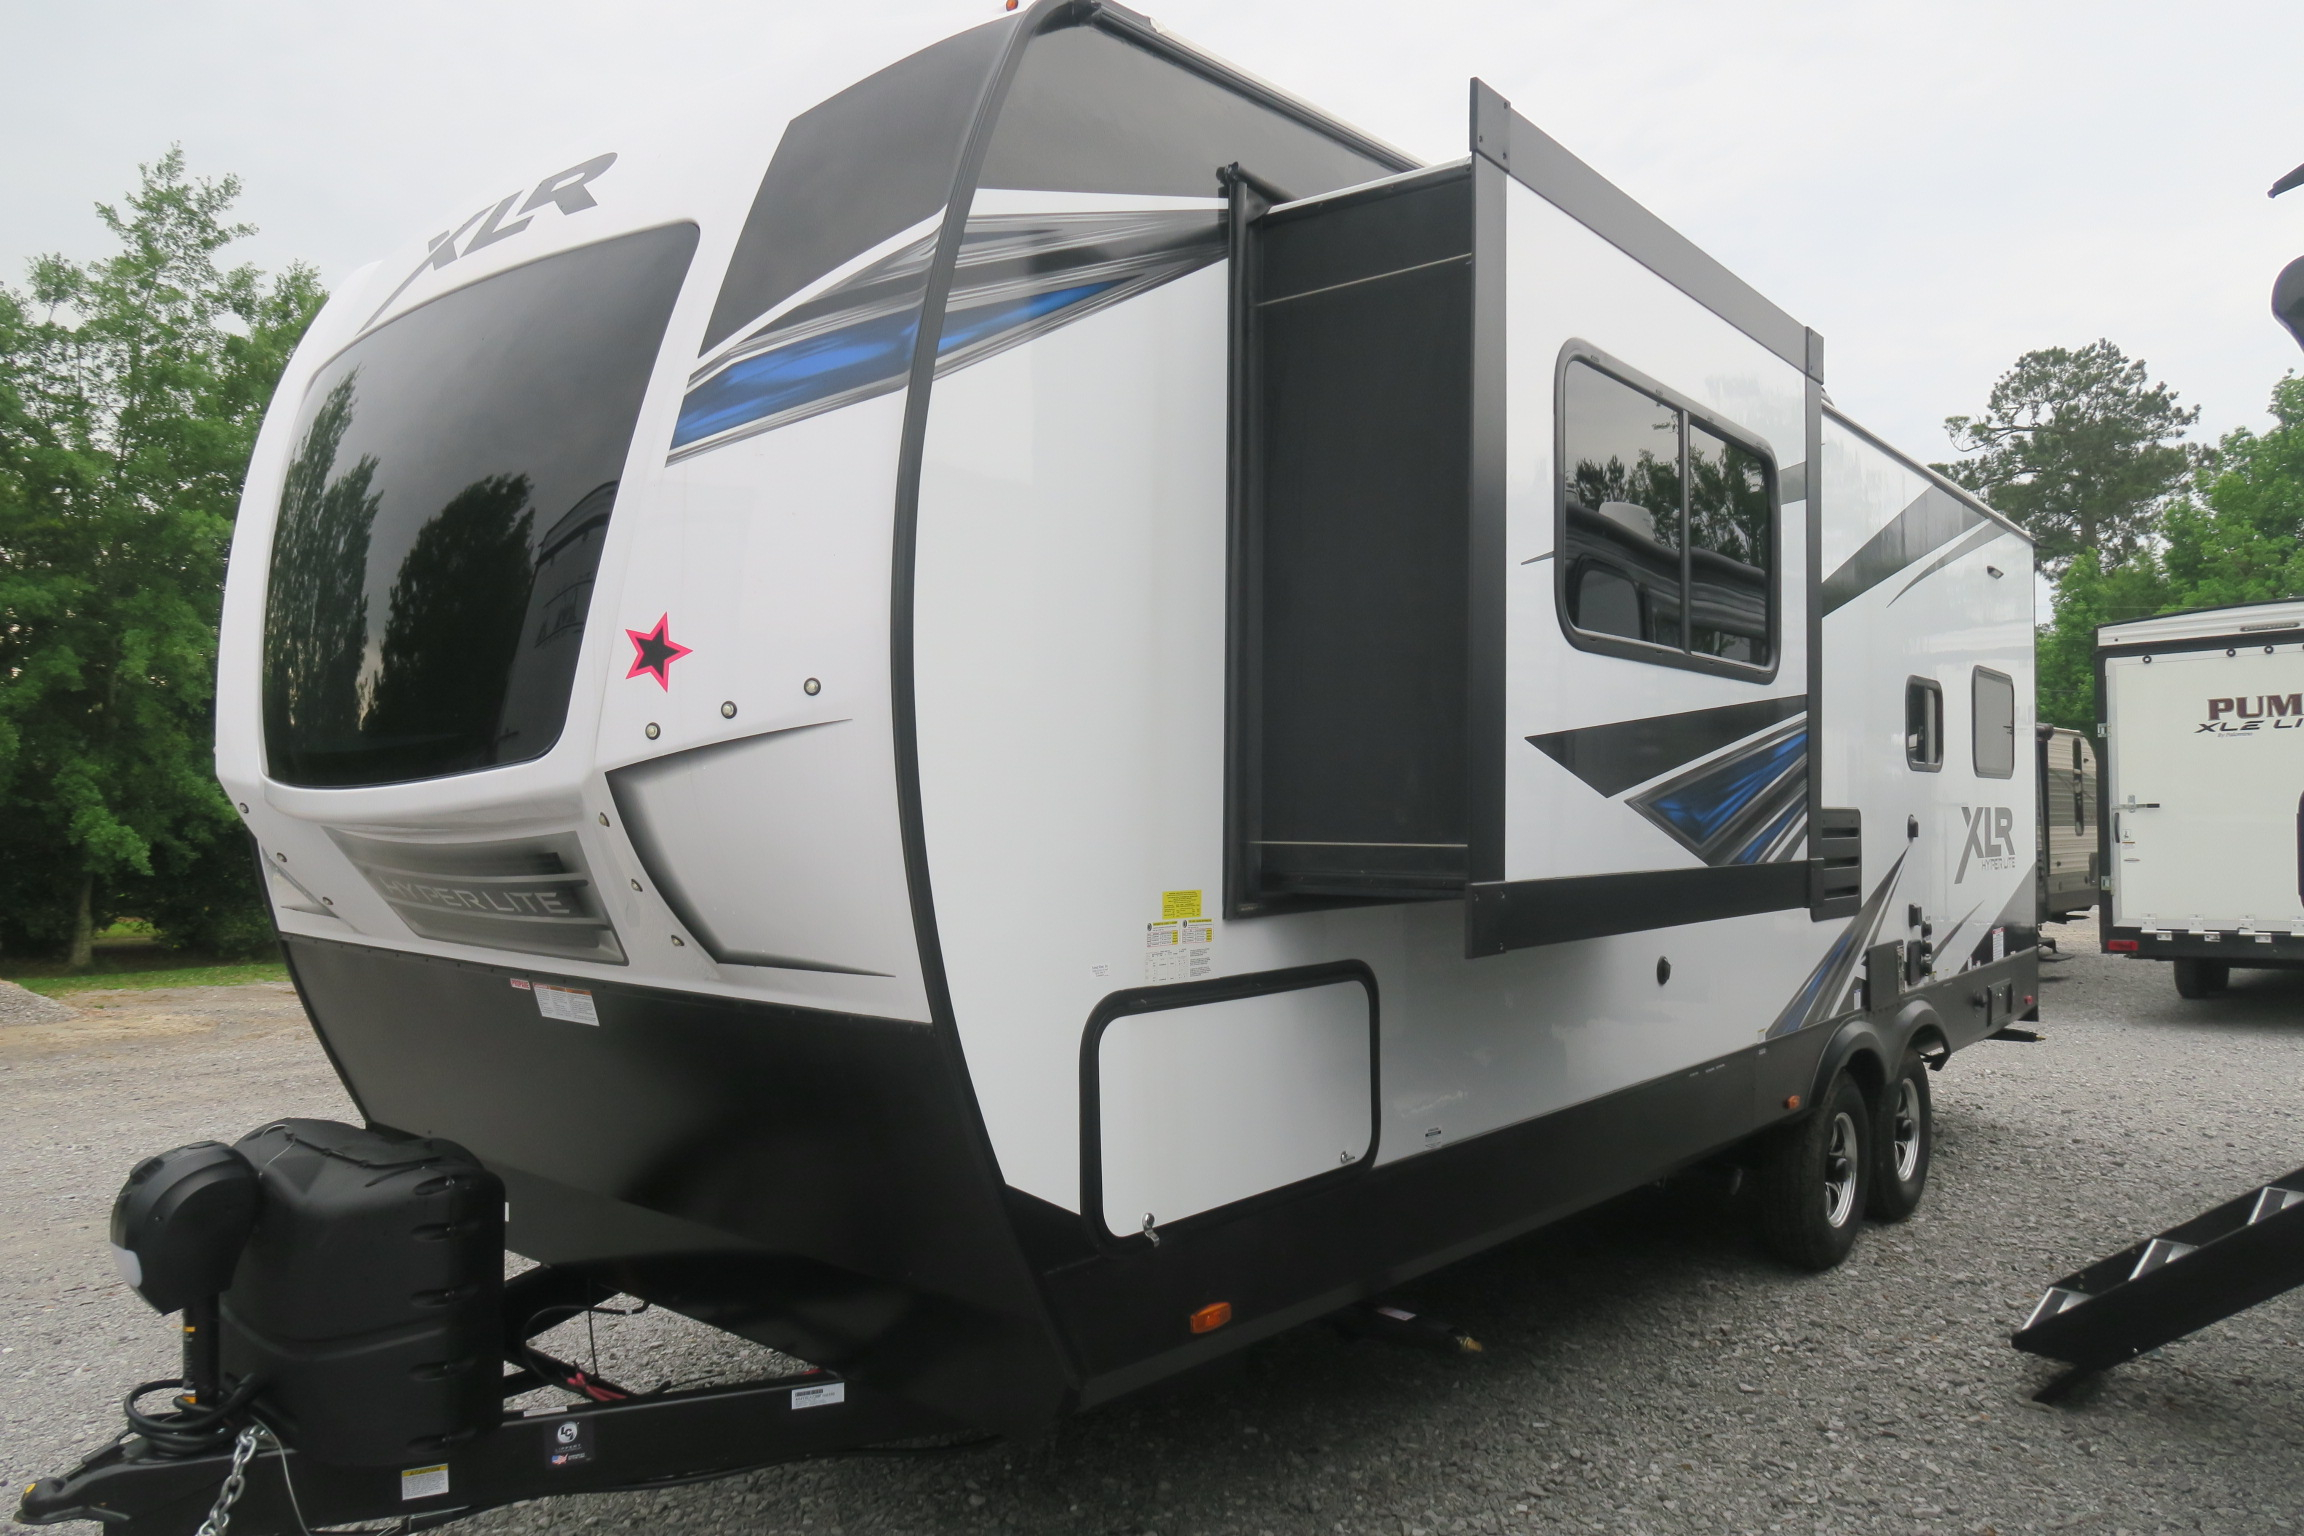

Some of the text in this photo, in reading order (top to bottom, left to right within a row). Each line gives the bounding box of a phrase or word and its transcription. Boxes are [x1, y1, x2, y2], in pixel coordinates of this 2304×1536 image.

[354, 152, 618, 337] XLR
[2193, 720, 2265, 733] XLE
[2207, 693, 2304, 721] PUM
[1954, 806, 2016, 885] XLR
